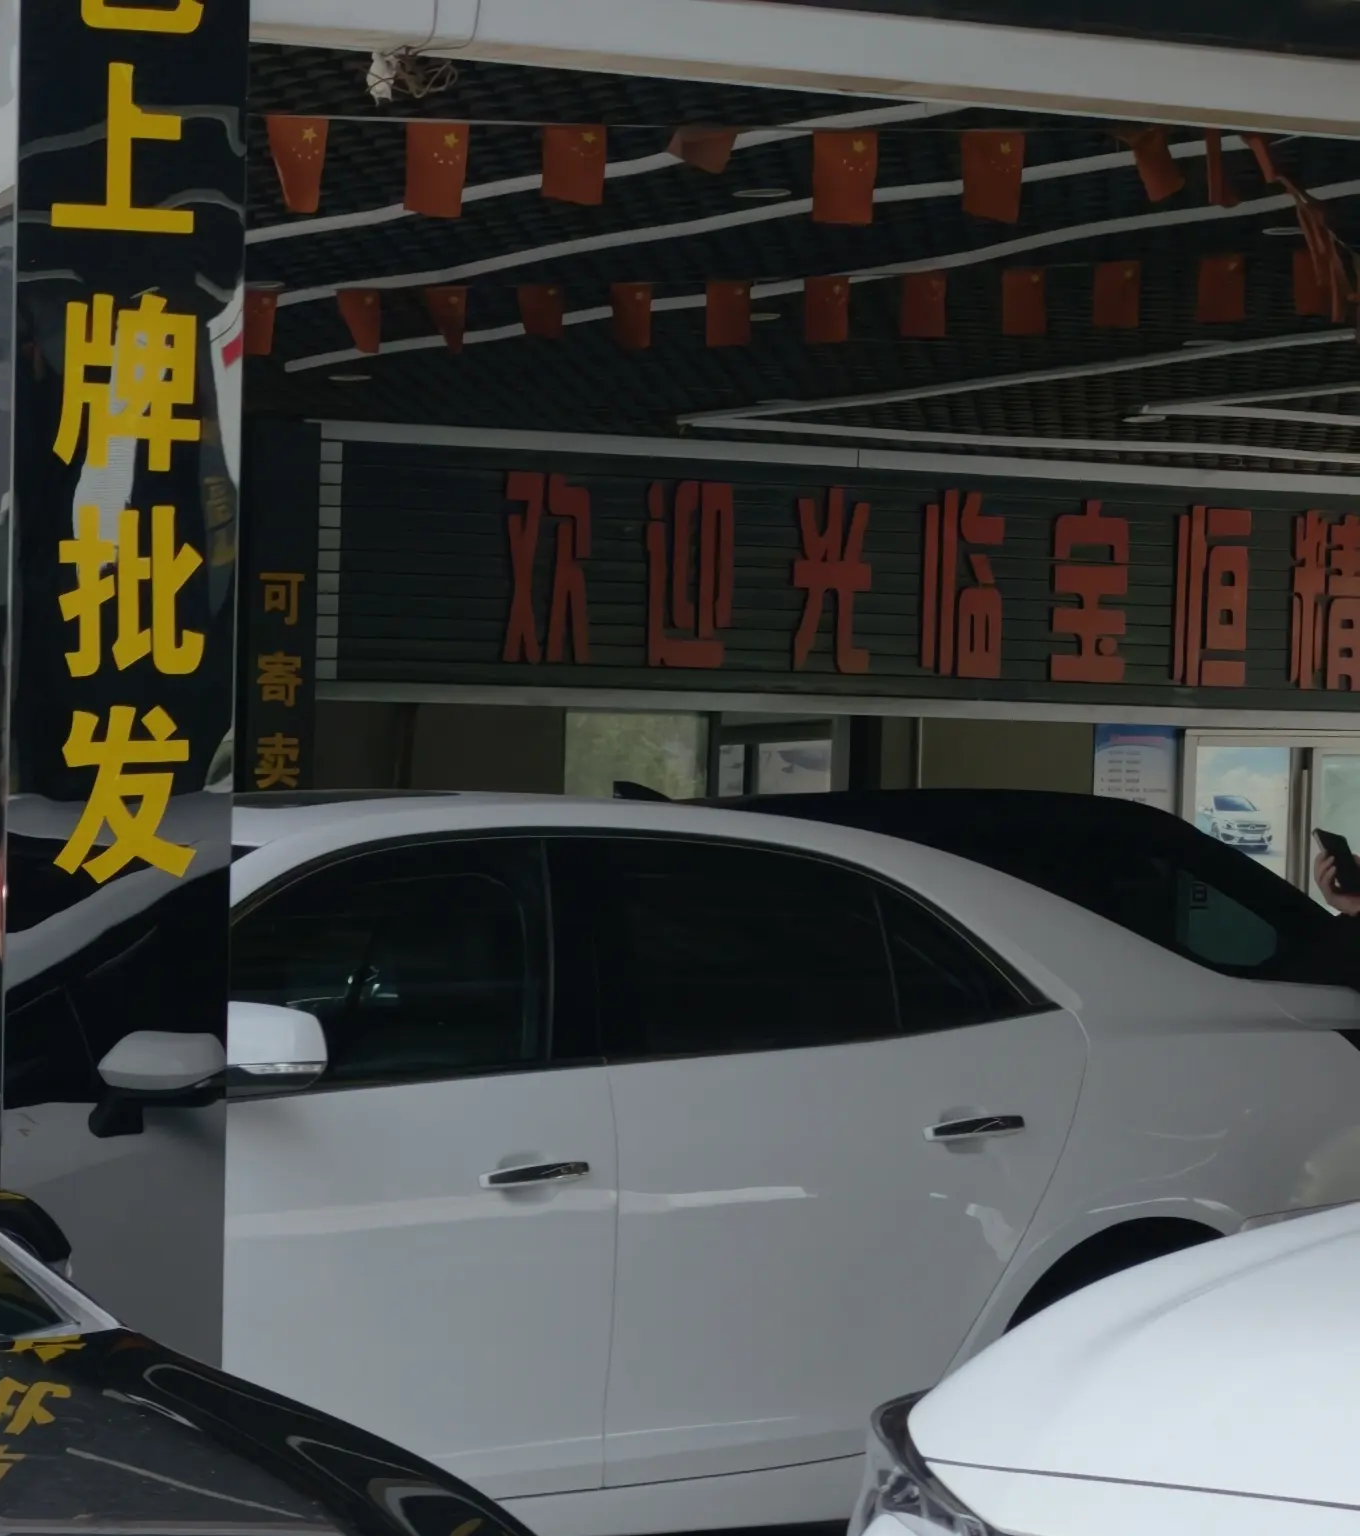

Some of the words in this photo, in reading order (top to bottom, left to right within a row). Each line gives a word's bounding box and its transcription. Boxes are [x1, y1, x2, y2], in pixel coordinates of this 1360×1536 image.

[50, 0, 206, 882] 上牌批发
[253, 572, 306, 791] 可寄卖
[501, 470, 1360, 692] 欢迎光临宝恒精
